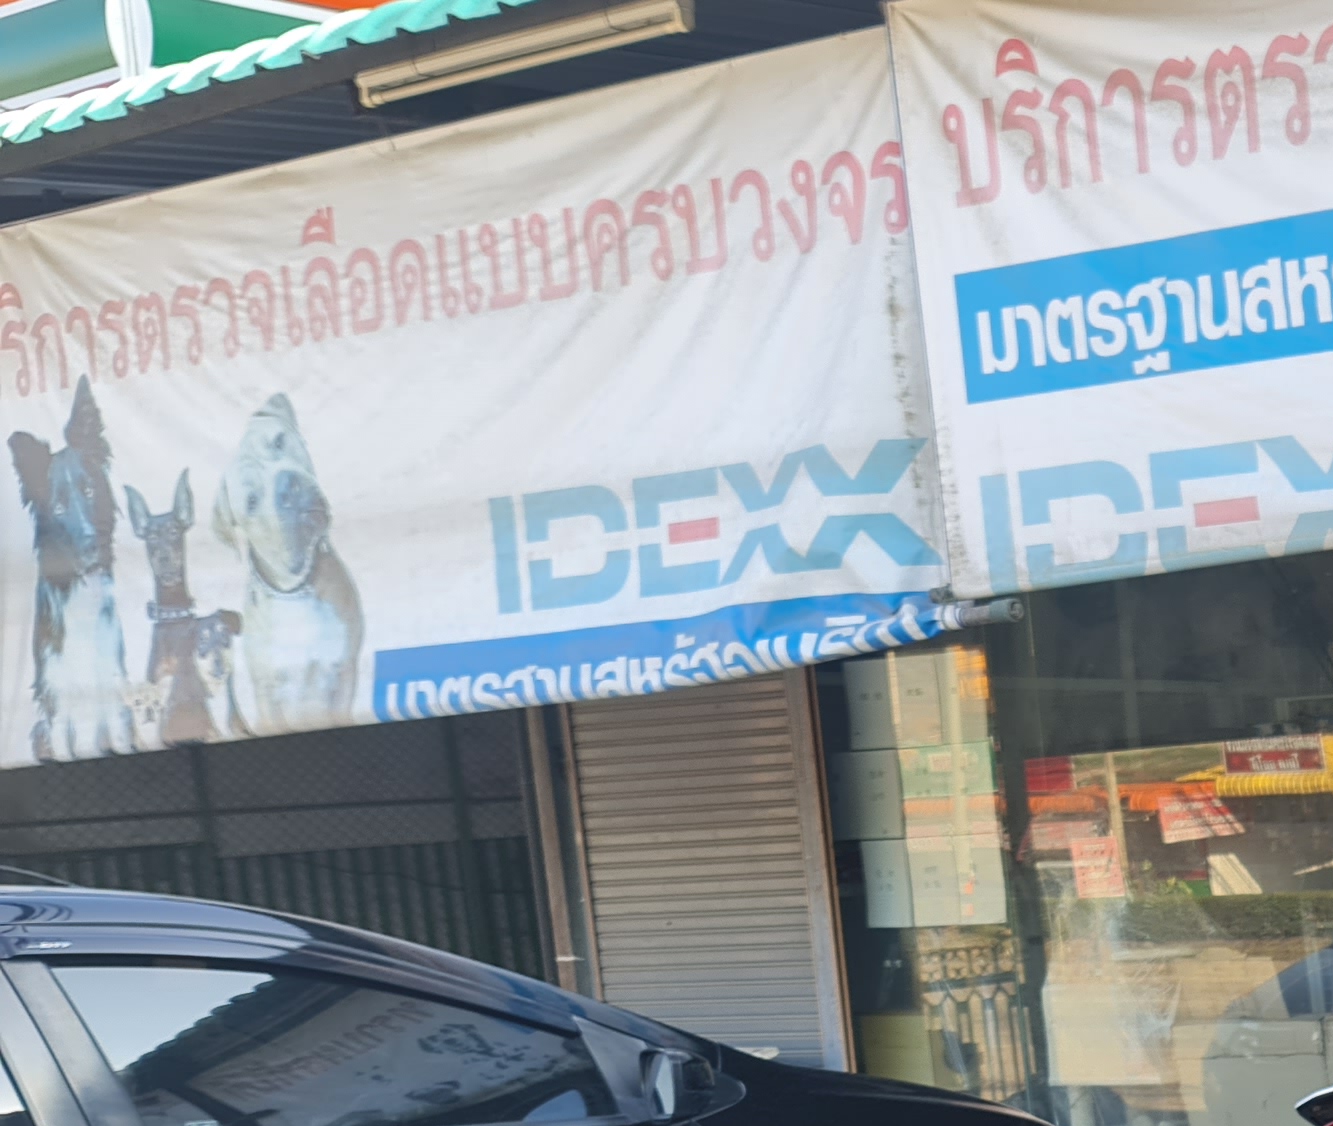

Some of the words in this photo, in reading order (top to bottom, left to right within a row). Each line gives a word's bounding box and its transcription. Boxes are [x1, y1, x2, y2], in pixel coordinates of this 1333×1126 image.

[0, 138, 910, 398] ริการตรวจเลือดแบบครบวงจร
[487, 437, 945, 615] IDEXX
